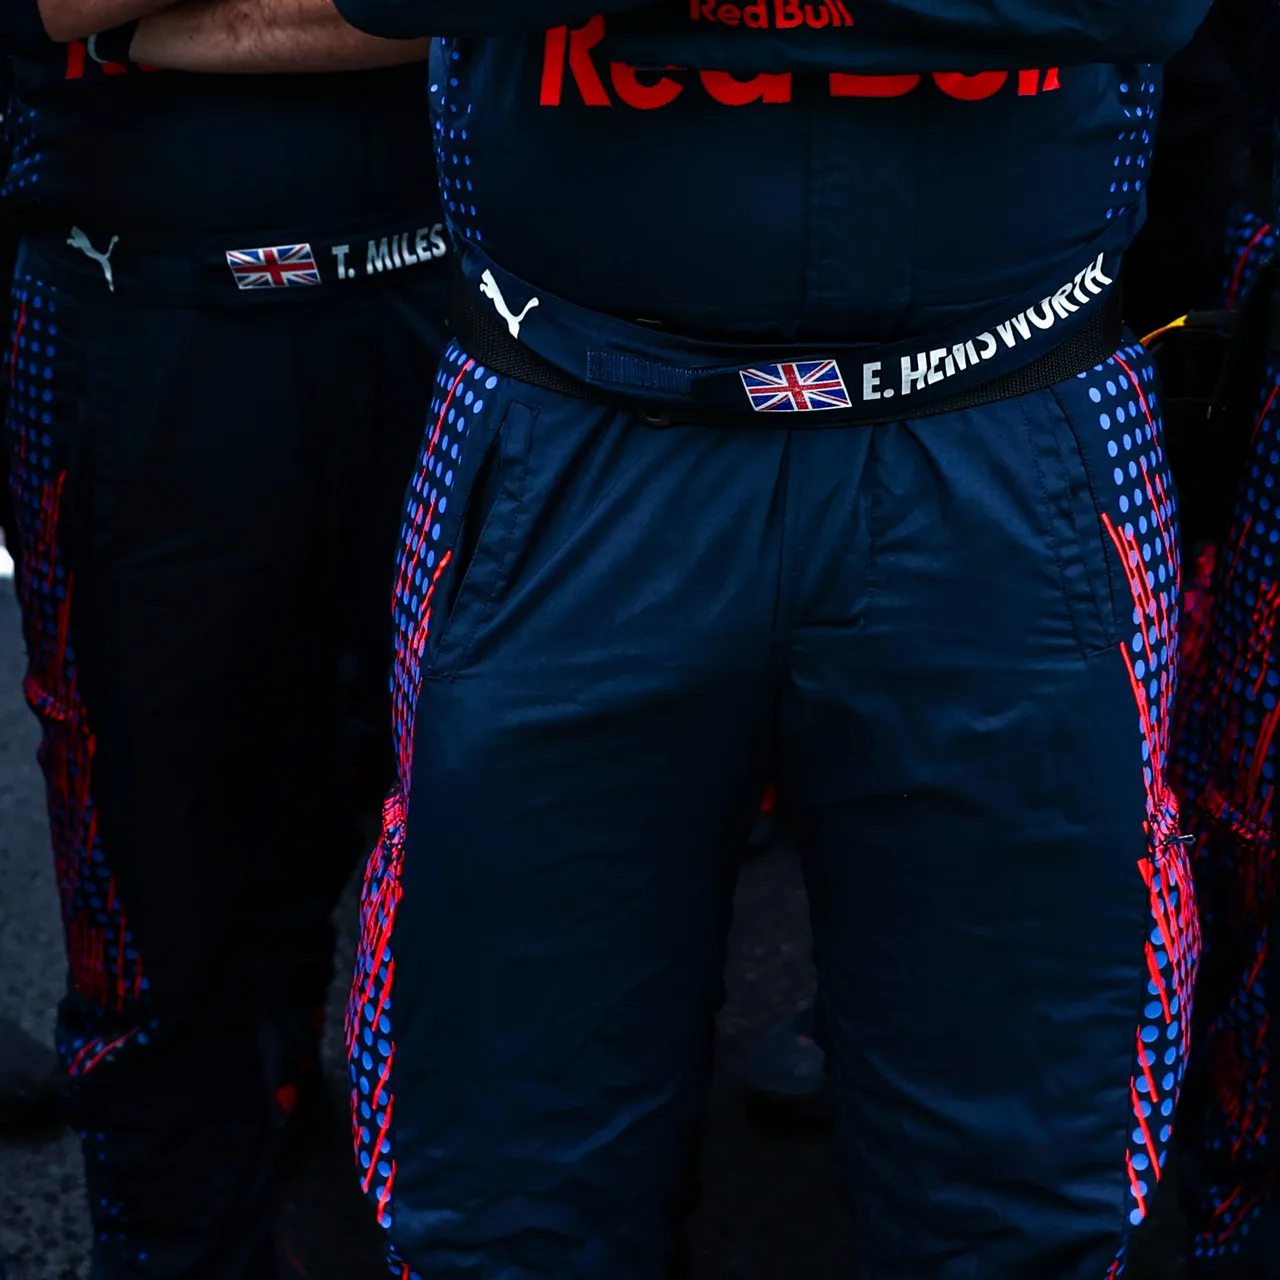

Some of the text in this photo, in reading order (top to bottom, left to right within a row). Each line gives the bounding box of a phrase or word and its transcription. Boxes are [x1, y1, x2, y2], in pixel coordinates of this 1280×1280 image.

[330, 222, 448, 280] T. MILES
[862, 252, 1114, 401] E. HEMSWORTH
